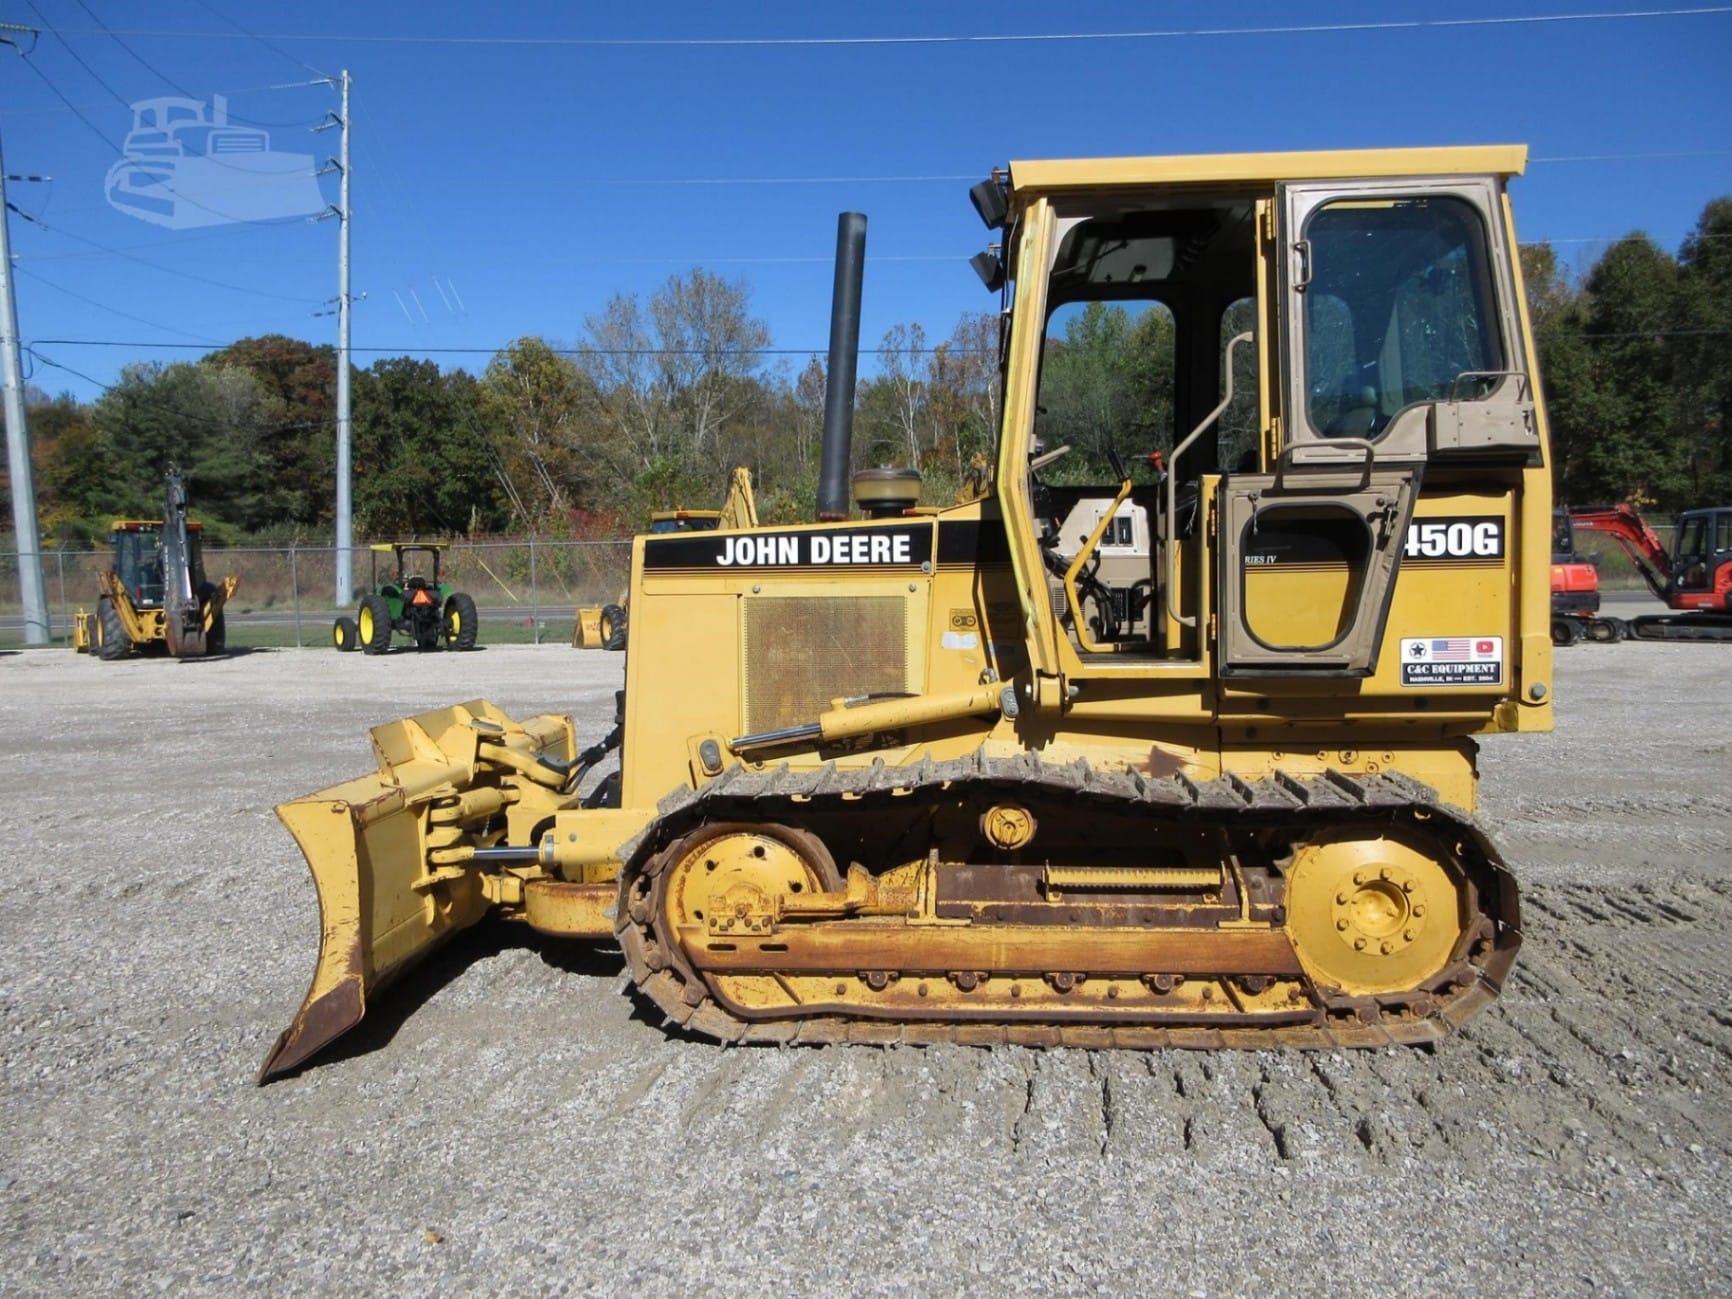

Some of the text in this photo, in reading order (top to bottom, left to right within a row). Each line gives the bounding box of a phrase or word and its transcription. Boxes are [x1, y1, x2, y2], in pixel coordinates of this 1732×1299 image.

[716, 535, 911, 566] JOHN DEERE
[1404, 522, 1498, 556] 450G
[1407, 663, 1496, 674] C&C EQUIPMENT
